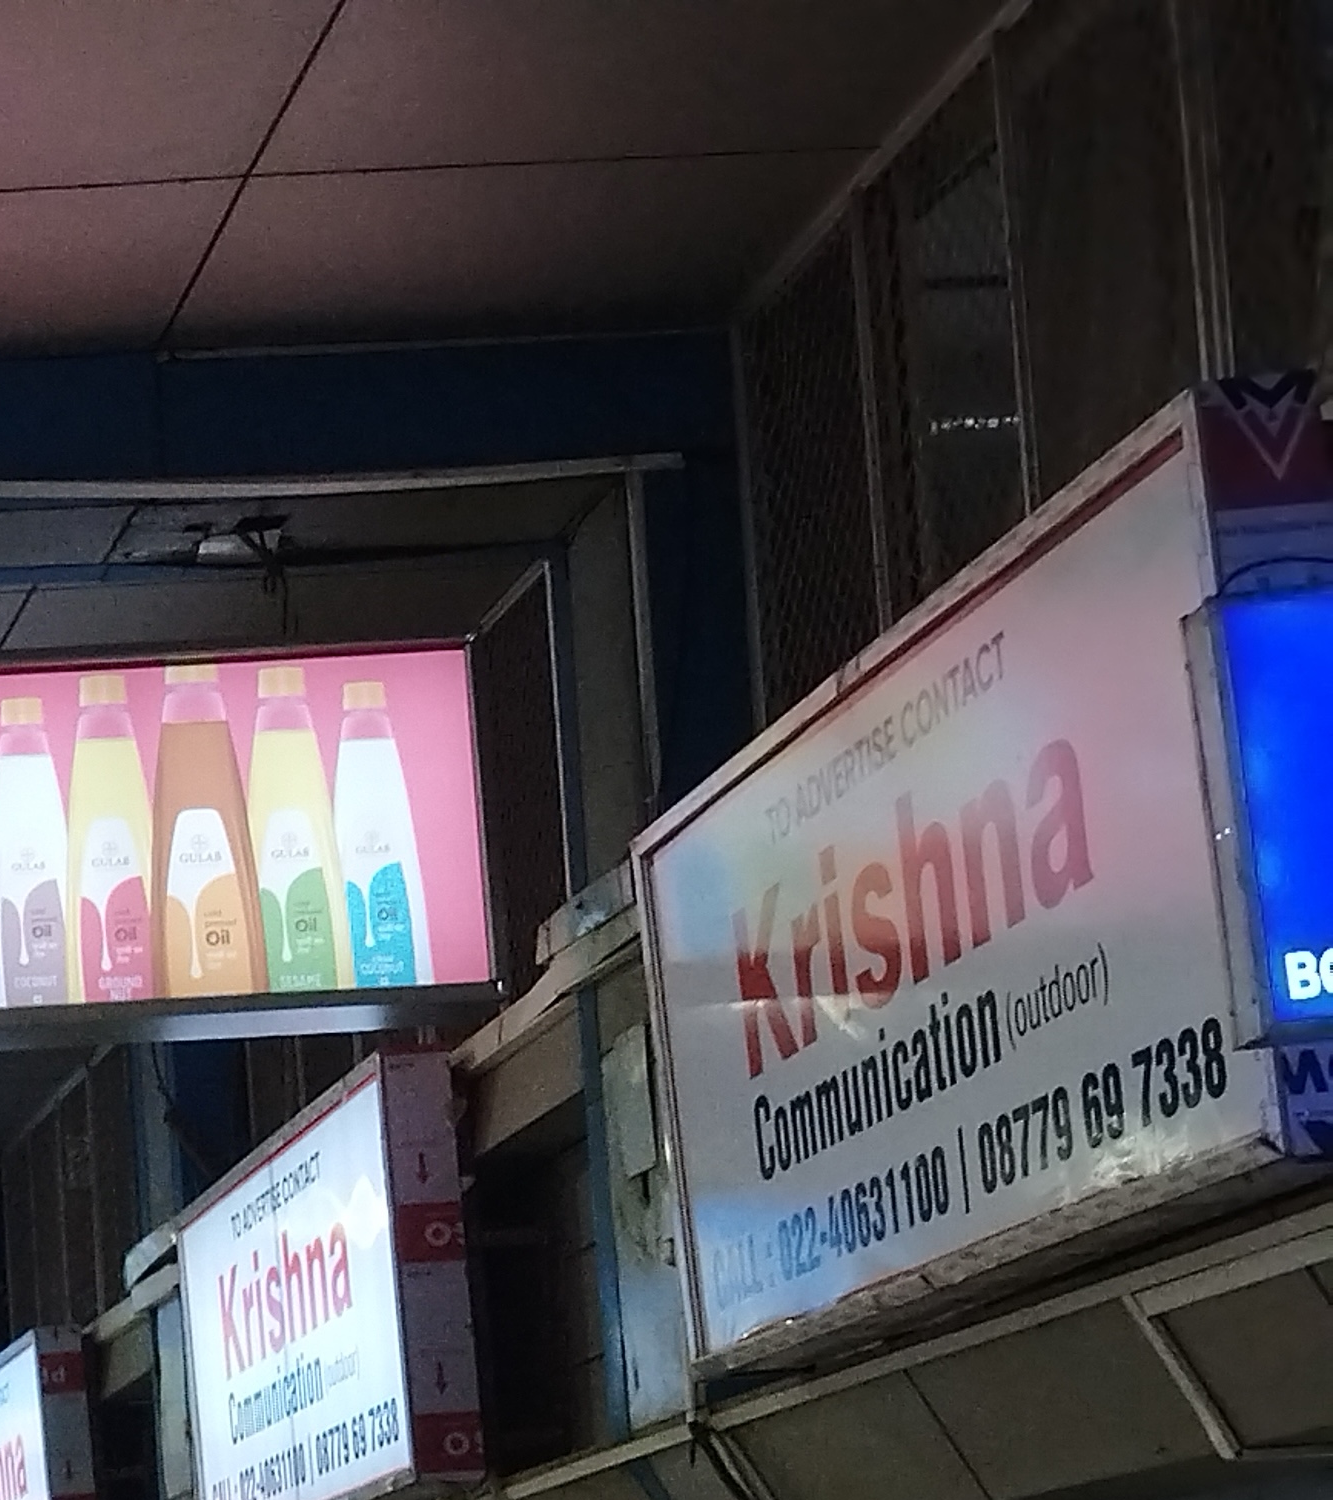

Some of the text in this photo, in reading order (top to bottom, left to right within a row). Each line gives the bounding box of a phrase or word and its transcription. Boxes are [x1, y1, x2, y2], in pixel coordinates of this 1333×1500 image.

[764, 631, 1005, 845] TO ADVERTISE CONTACT
[205, 930, 230, 946] Oil
[732, 737, 1095, 1081] Krishna
[753, 942, 1110, 1181] Communication (outdoor)
[777, 1145, 948, 1281] 022-40631100
[978, 1086, 1072, 1195] 08779
[1081, 1062, 1125, 1150] 69
[1132, 1017, 1228, 1128] 7338
[218, 1222, 353, 1381] Krishna
